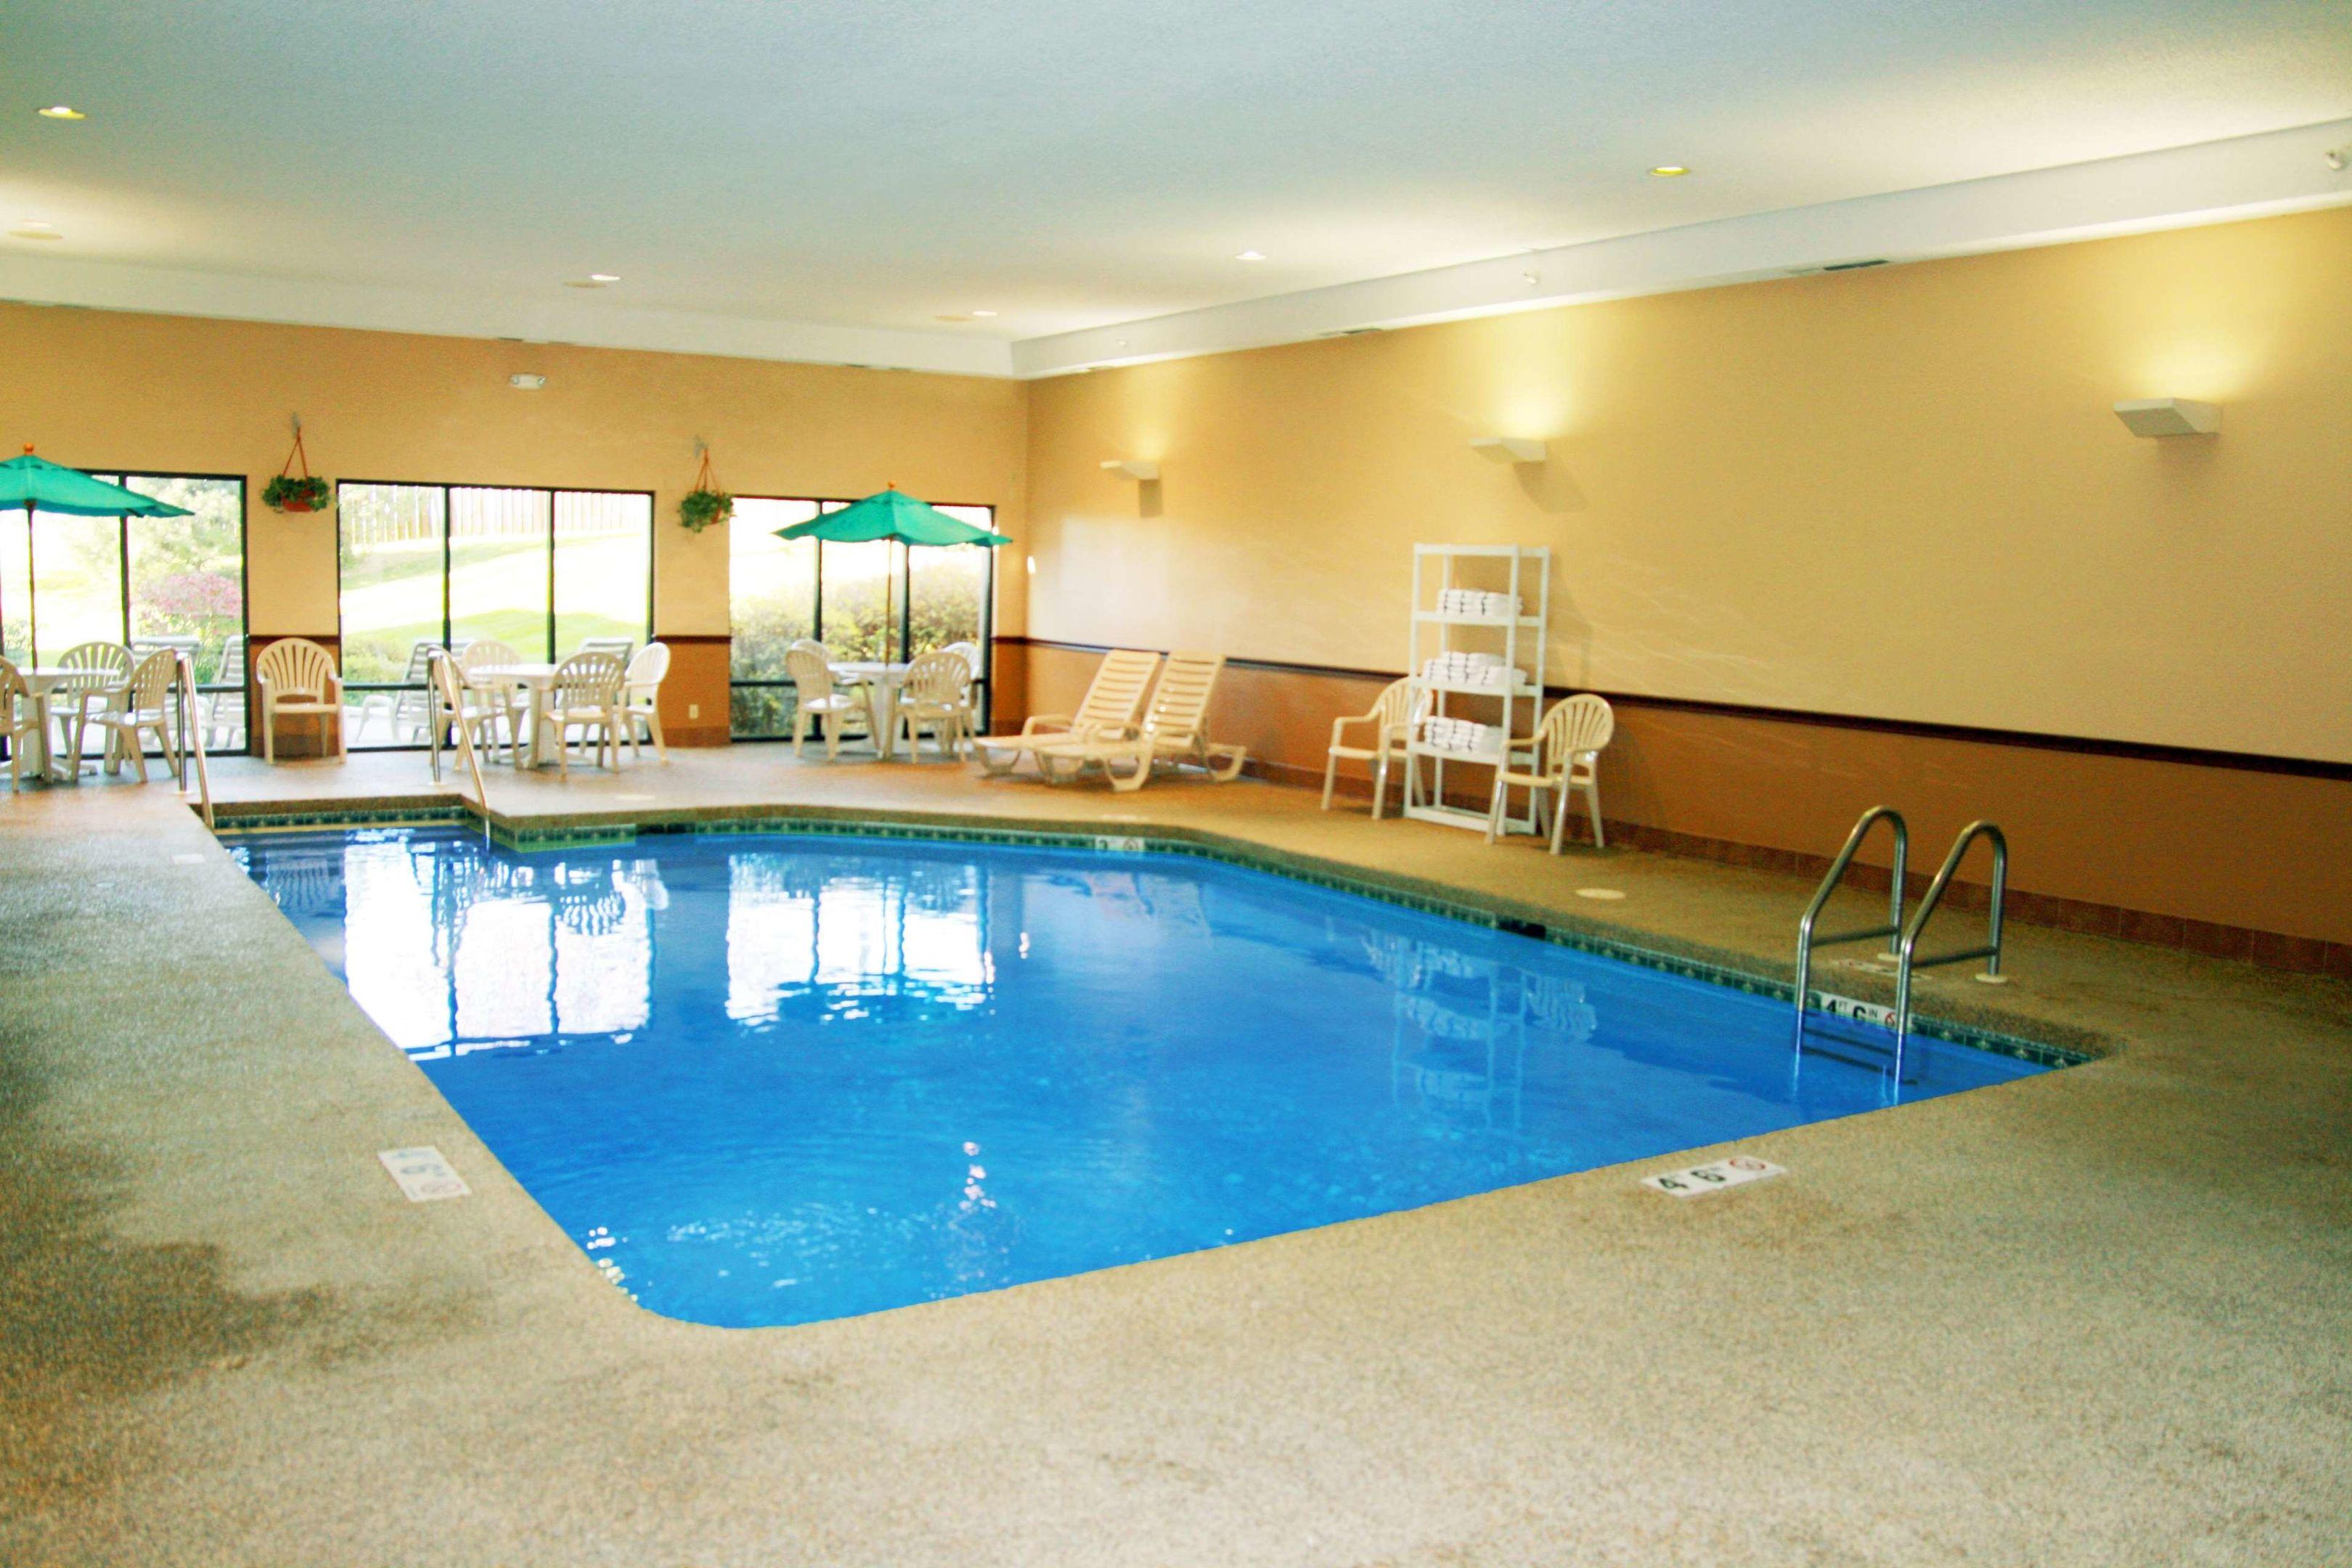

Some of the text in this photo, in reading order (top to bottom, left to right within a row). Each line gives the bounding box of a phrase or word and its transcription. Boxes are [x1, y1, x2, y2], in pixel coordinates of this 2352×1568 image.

[1826, 1000, 1837, 1012] 4
[1838, 1001, 1847, 1010] FT
[1868, 1009, 1879, 1018] IN
[1658, 1177, 1689, 1189] 4
[1690, 1169, 1726, 1182] 6
